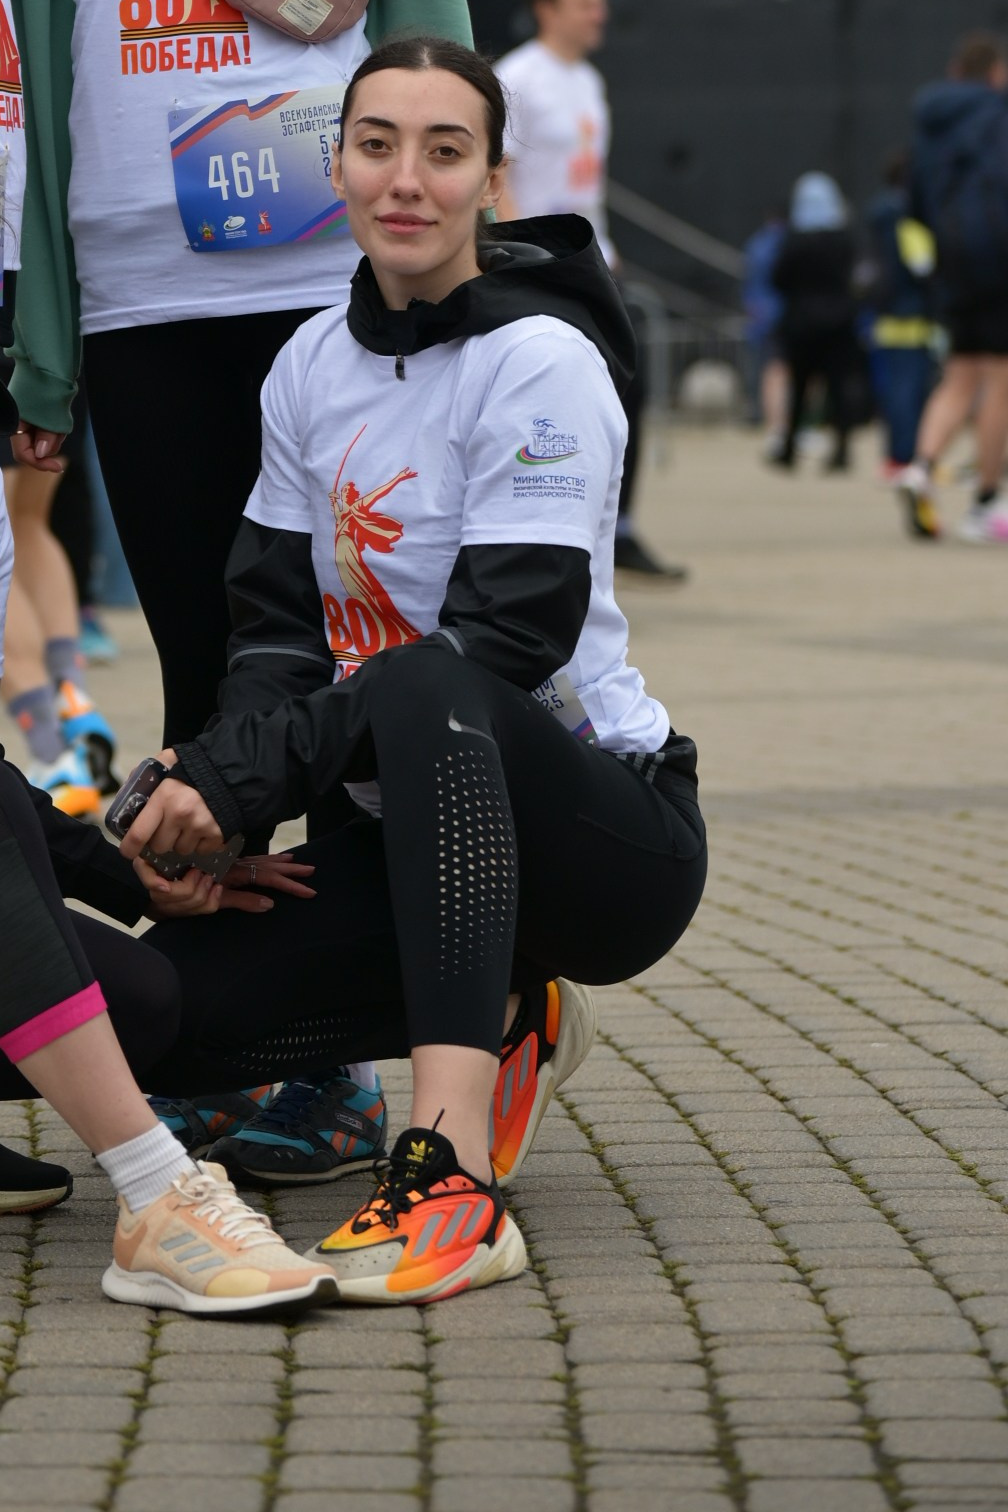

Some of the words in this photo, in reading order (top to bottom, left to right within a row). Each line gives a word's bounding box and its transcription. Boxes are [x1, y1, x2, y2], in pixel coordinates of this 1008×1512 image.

[120, 34, 252, 75] ПОБЕДА!
[279, 102, 342, 123] ВСЕКУБАНСКАЯ
[281, 118, 328, 137] ЭСТАФЕТА
[319, 134, 329, 155] 5
[208, 147, 281, 201] 464
[513, 475, 586, 488] МИНИСТЕРСТВО
[323, 593, 381, 656] 80
